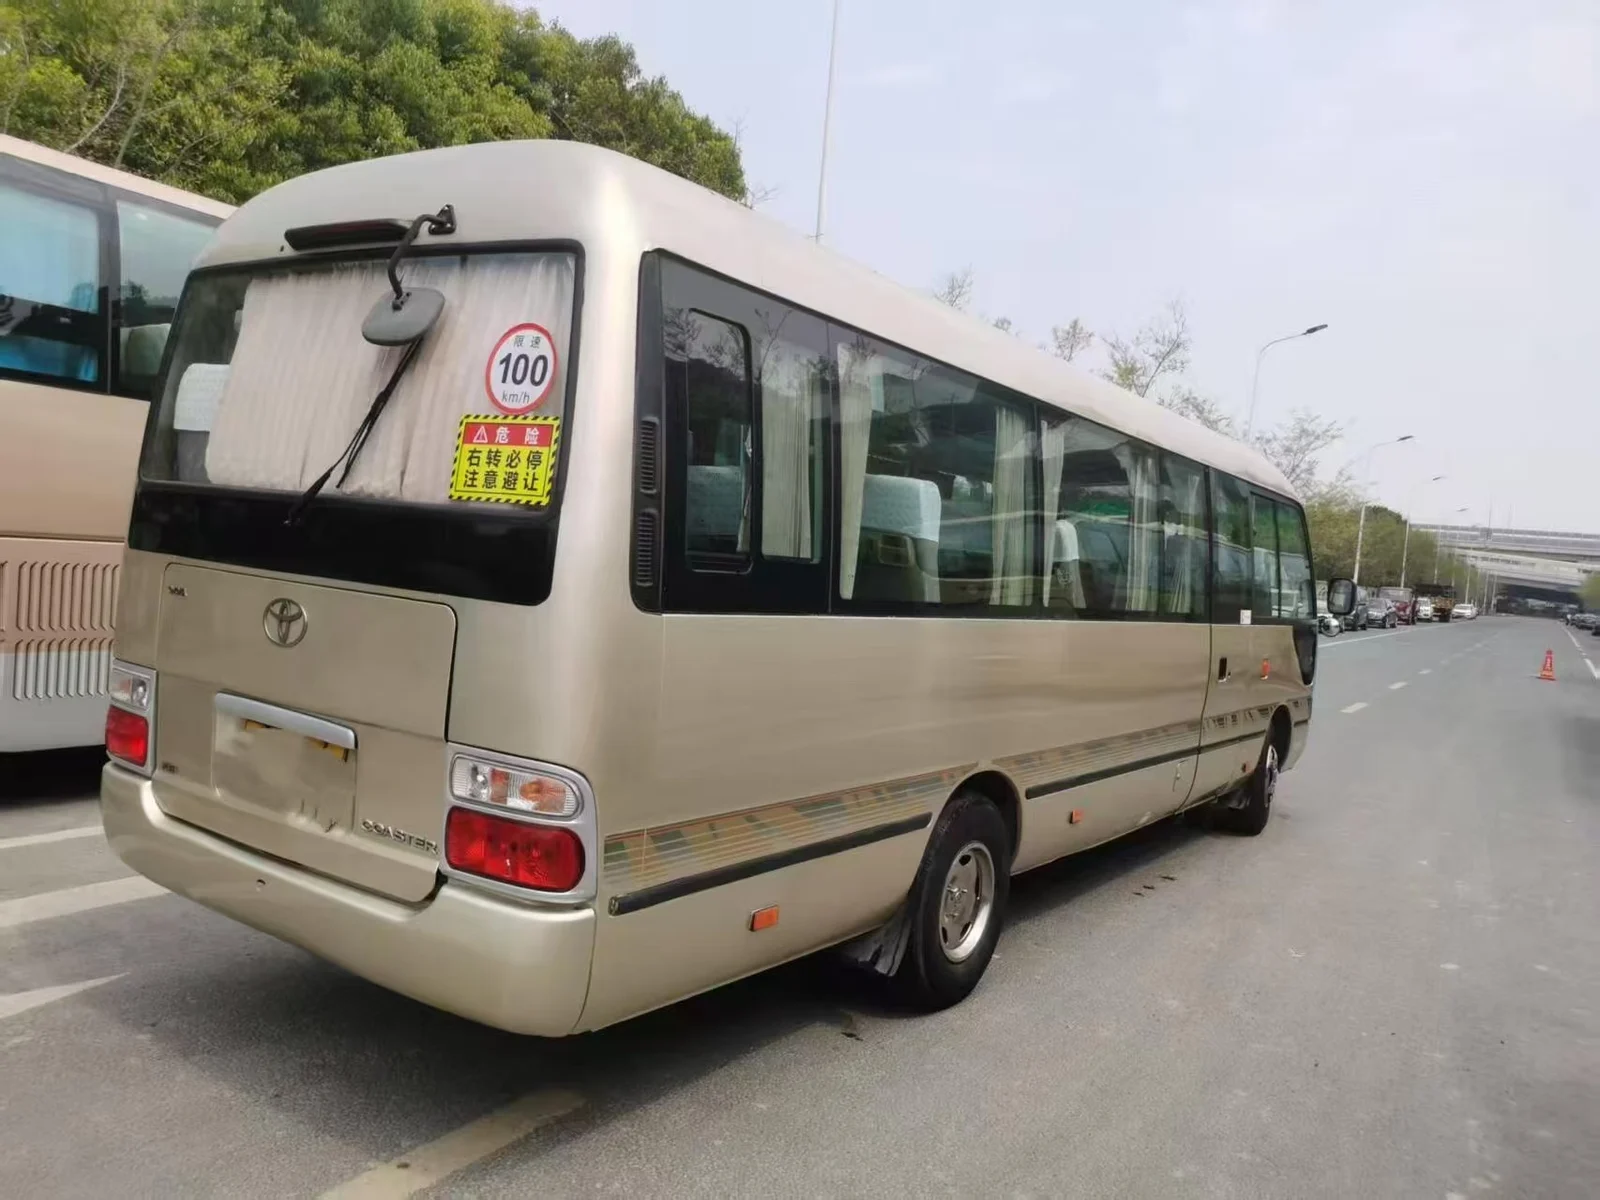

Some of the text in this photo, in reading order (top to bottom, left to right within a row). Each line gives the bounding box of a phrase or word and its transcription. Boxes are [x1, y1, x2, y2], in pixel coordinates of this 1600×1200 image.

[514, 335, 541, 348] 限速
[499, 353, 549, 387] 100
[502, 391, 530, 403] km/h
[495, 426, 539, 444] 危险
[467, 448, 543, 470] 右转必停
[463, 470, 539, 492] 注意避让
[361, 819, 438, 855] COASTER
